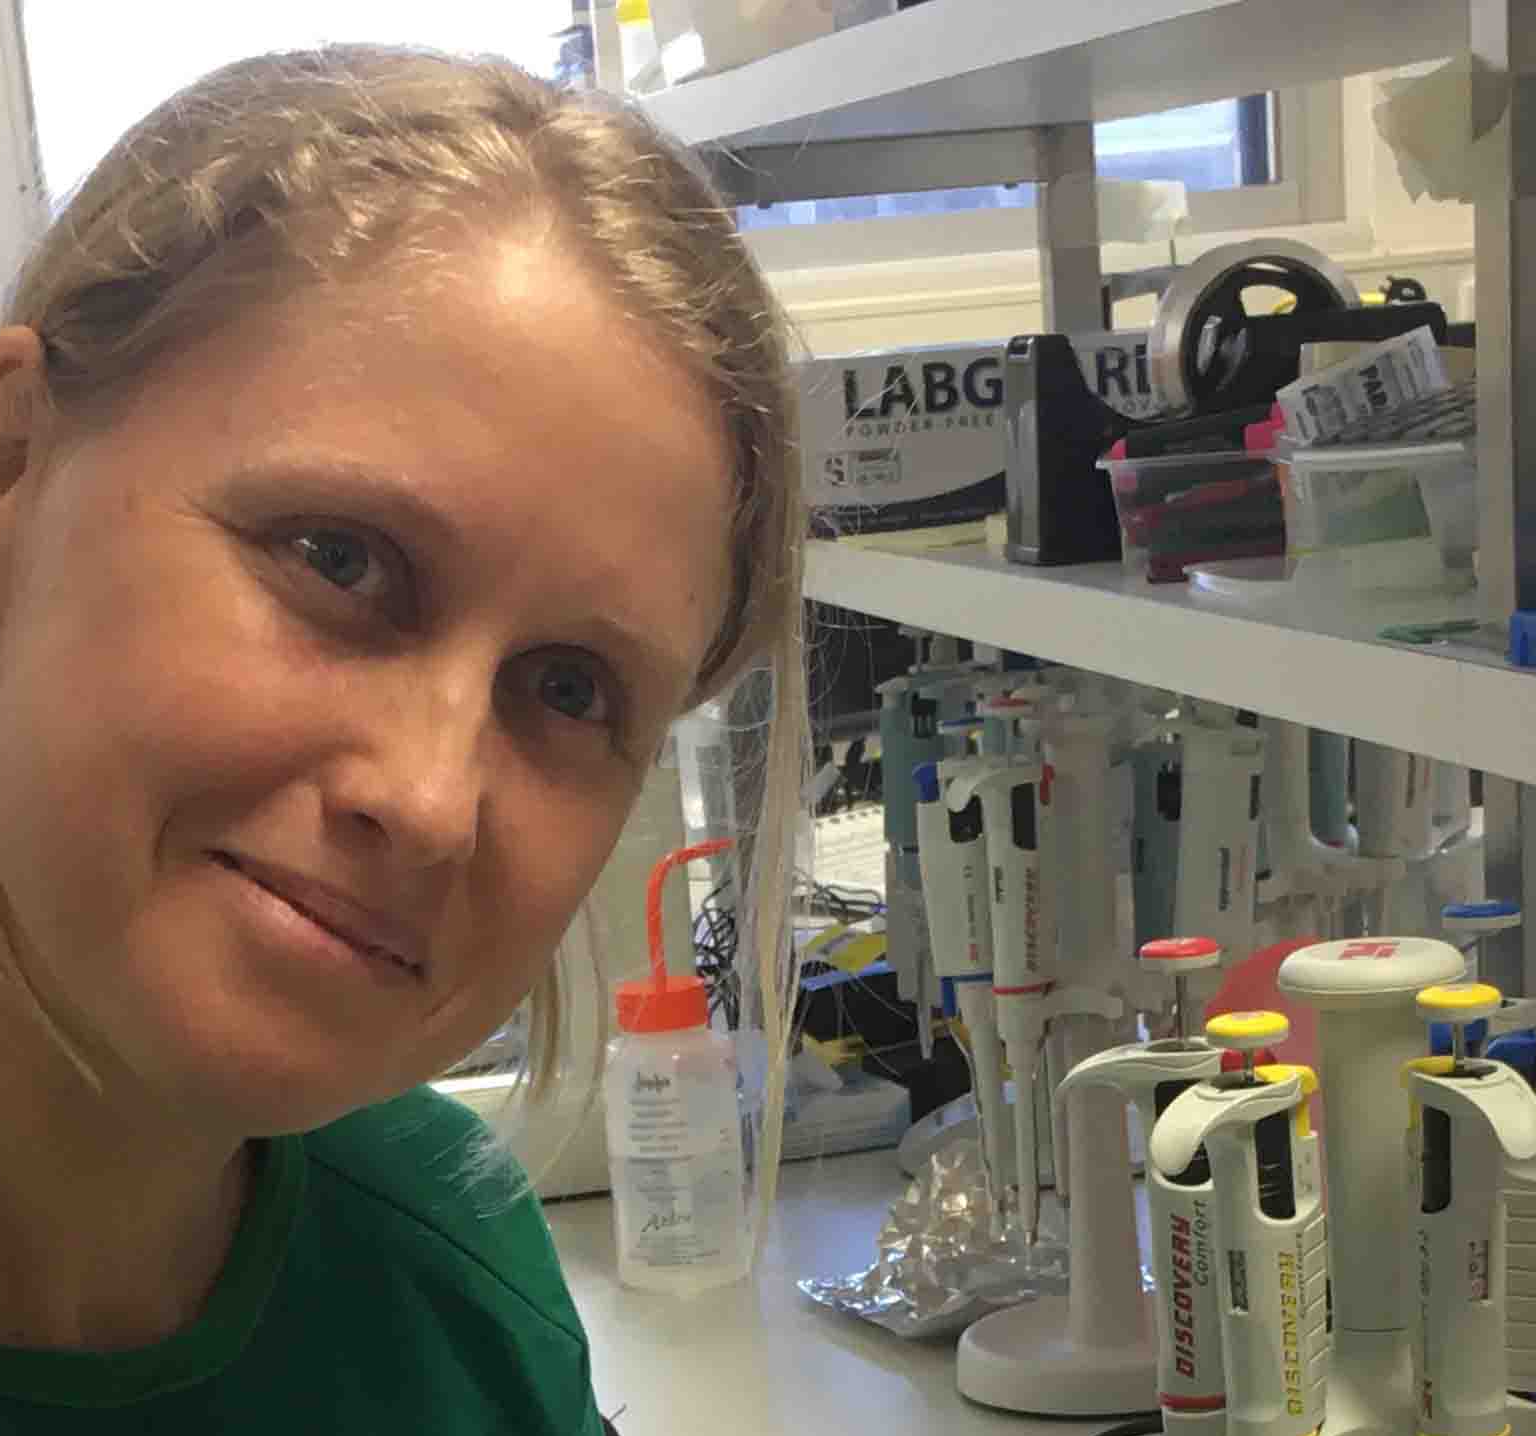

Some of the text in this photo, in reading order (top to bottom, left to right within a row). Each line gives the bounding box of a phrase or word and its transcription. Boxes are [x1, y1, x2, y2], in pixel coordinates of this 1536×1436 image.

[1170, 1213, 1195, 1380] DISCOVERY
[1194, 1199, 1209, 1287] Comfort
[1278, 1251, 1304, 1416] DISCOVERY
